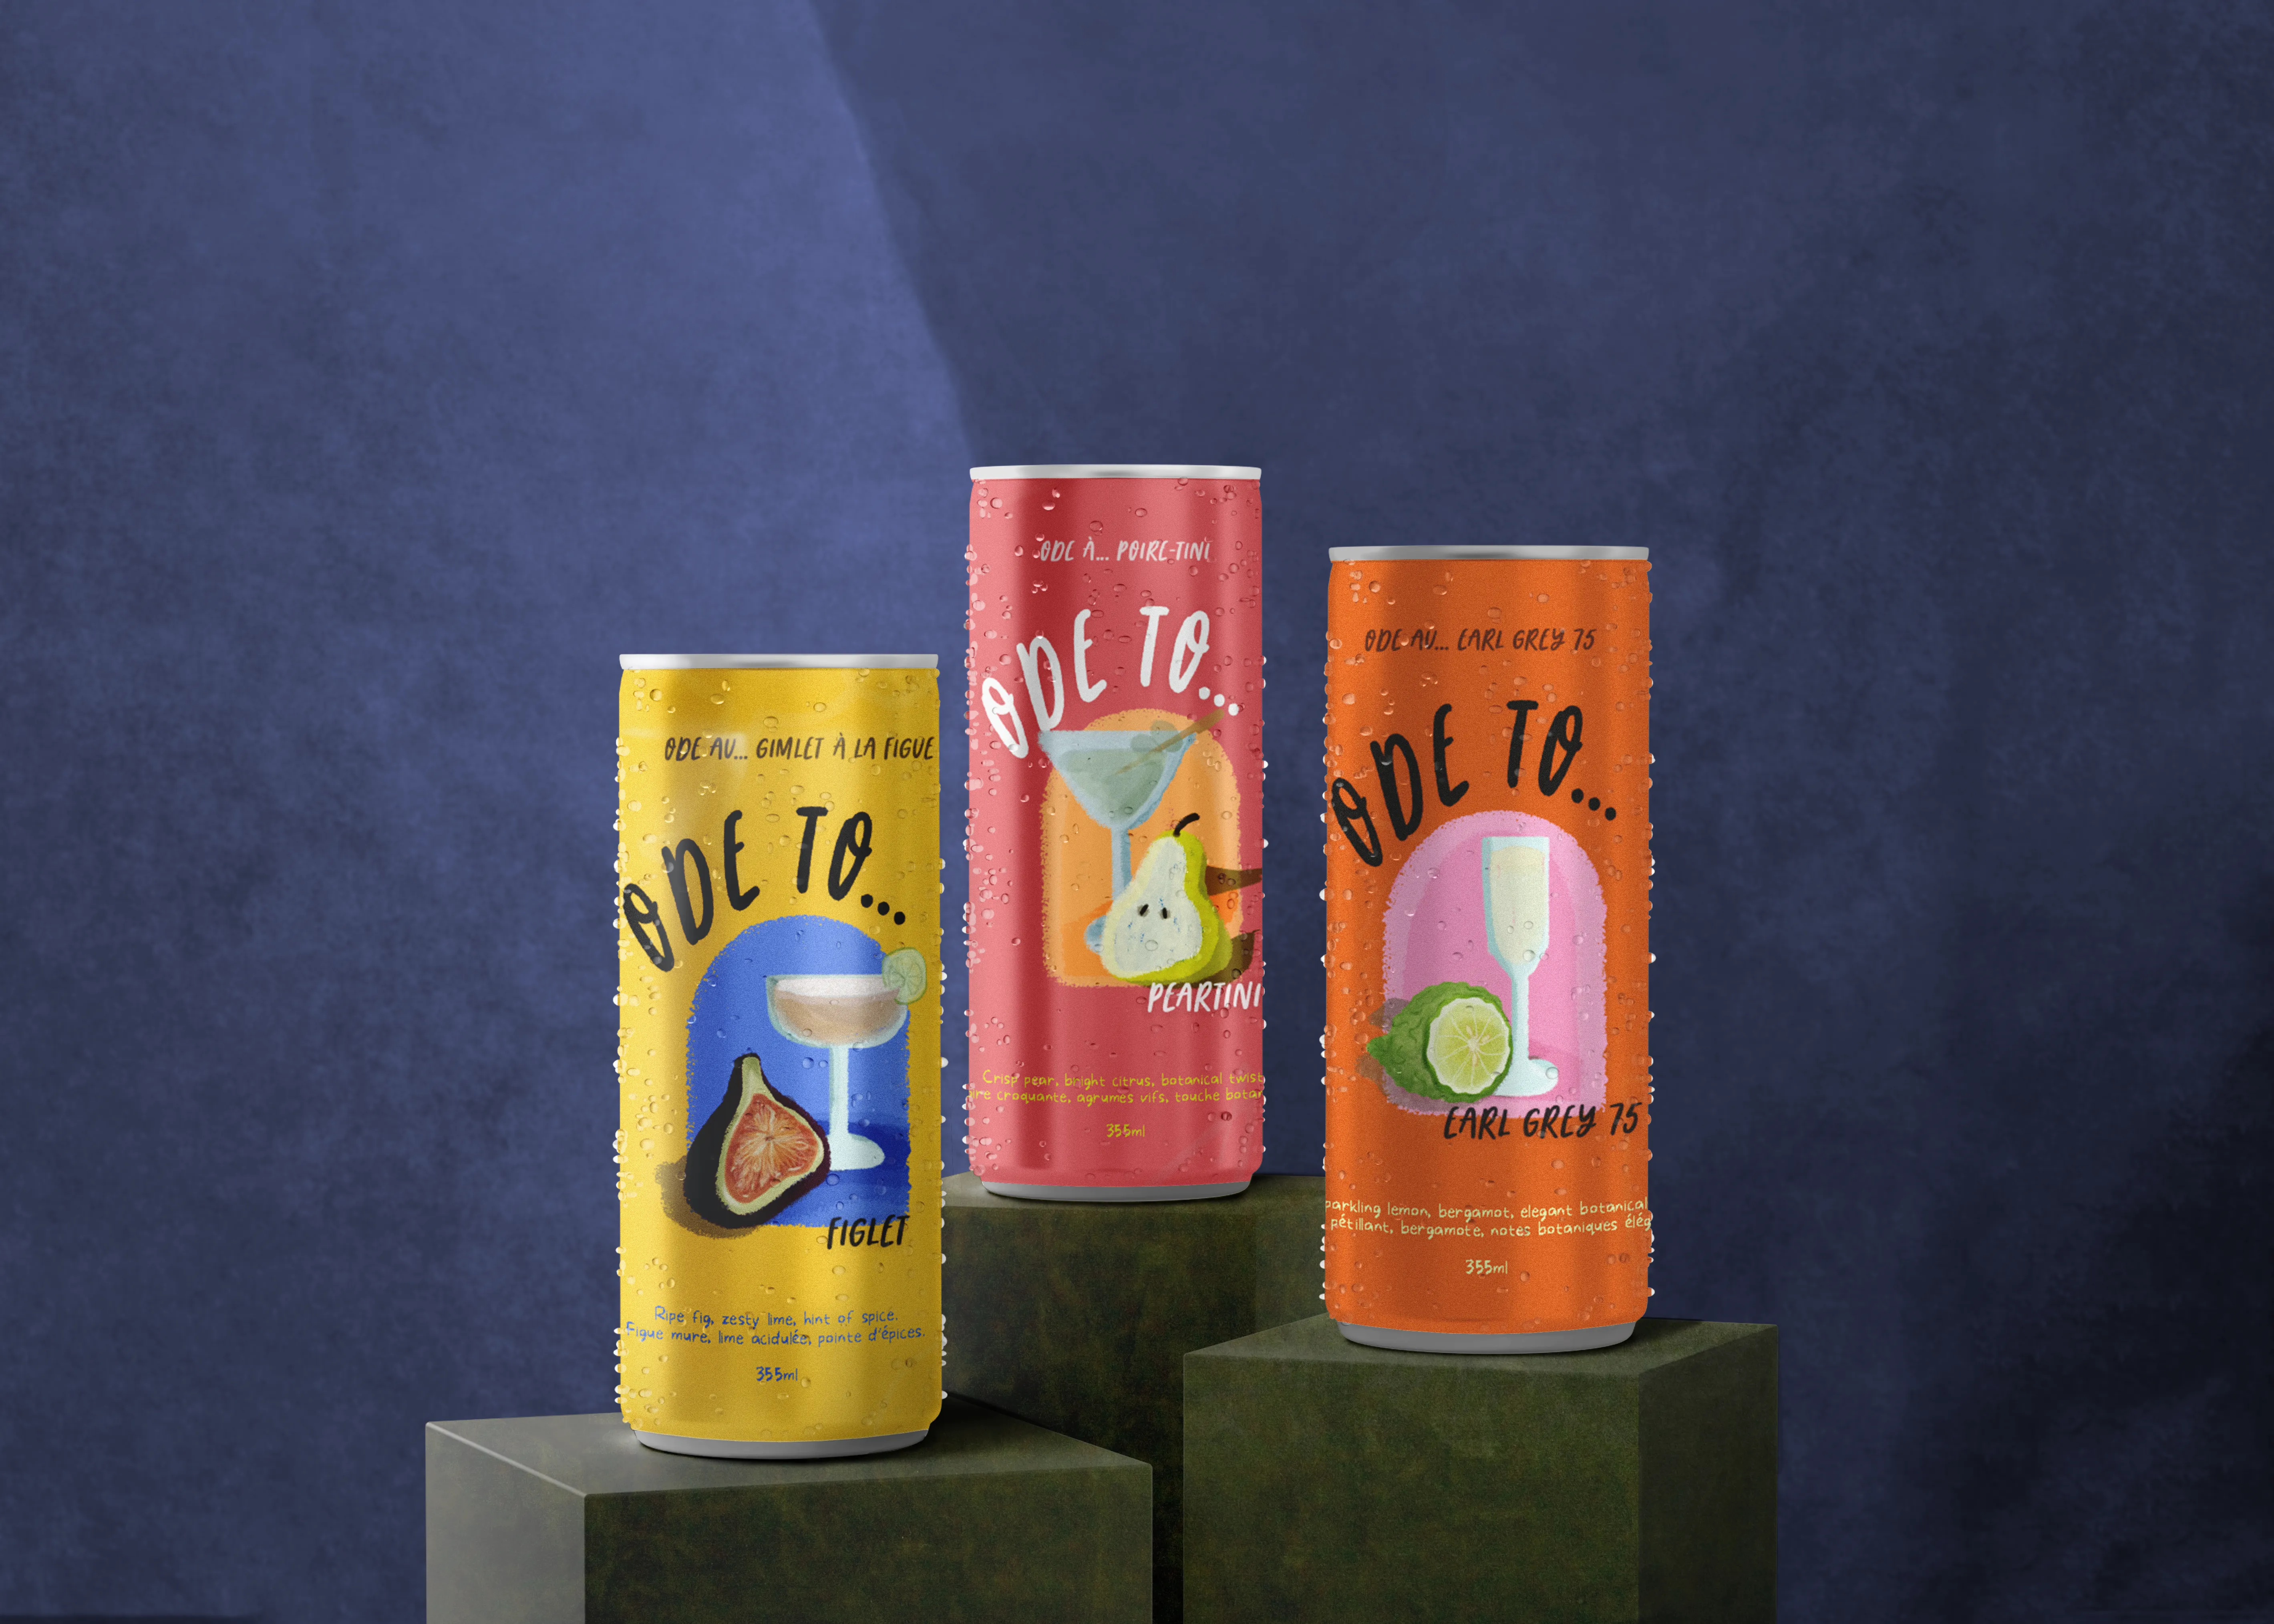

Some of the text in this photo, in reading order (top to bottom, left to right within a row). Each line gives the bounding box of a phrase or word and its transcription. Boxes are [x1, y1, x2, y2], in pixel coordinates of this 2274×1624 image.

[1041, 536, 1209, 561] ODE À... POIRE-TINI
[1365, 628, 1597, 651] ODE AU... EARL GREY 75
[982, 606, 1239, 758] ODE TO...
[665, 732, 934, 761] ODE AU... GIMLET À LA FIGUE
[1332, 700, 1616, 867] ODE TO...
[624, 807, 906, 972] ODE TO...
[1148, 981, 1261, 1012] PEARTINI
[983, 1069, 1017, 1087] Crisp
[1024, 1076, 1058, 1088] pear,
[1065, 1073, 1105, 1090] bright
[1112, 1076, 1154, 1087] citrus,
[1161, 1072, 1222, 1087] botanical
[997, 1091, 1071, 1104] croquante,
[1077, 1093, 1133, 1107] agrumes
[1141, 1090, 1168, 1103] vifs,
[1175, 1088, 1220, 1102] touche
[1107, 1124, 1145, 1137] 355ml
[1444, 1103, 1642, 1139] EARL GREY 75
[1388, 1202, 1431, 1218] lemon,
[1439, 1203, 1513, 1223] bergamot,
[1521, 1205, 1572, 1221] elegant
[1580, 1196, 1647, 1215] botanical
[827, 1215, 910, 1249] FIGLET
[1331, 1213, 1393, 1234] pétillant,
[1401, 1220, 1484, 1240] bergamote,
[1491, 1224, 1531, 1237] notes
[1538, 1220, 1617, 1236] botaniques
[1466, 1260, 1508, 1274] 355ml
[655, 1306, 898, 1329] Ripe fig, zesty lime, hint of spice.
[626, 1321, 663, 1341] Figue
[672, 1332, 710, 1344] mure,
[719, 1331, 743, 1344] lime
[752, 1330, 811, 1345] acidulée,
[819, 1332, 861, 1347] pointe
[757, 1366, 797, 1381] 355ml
